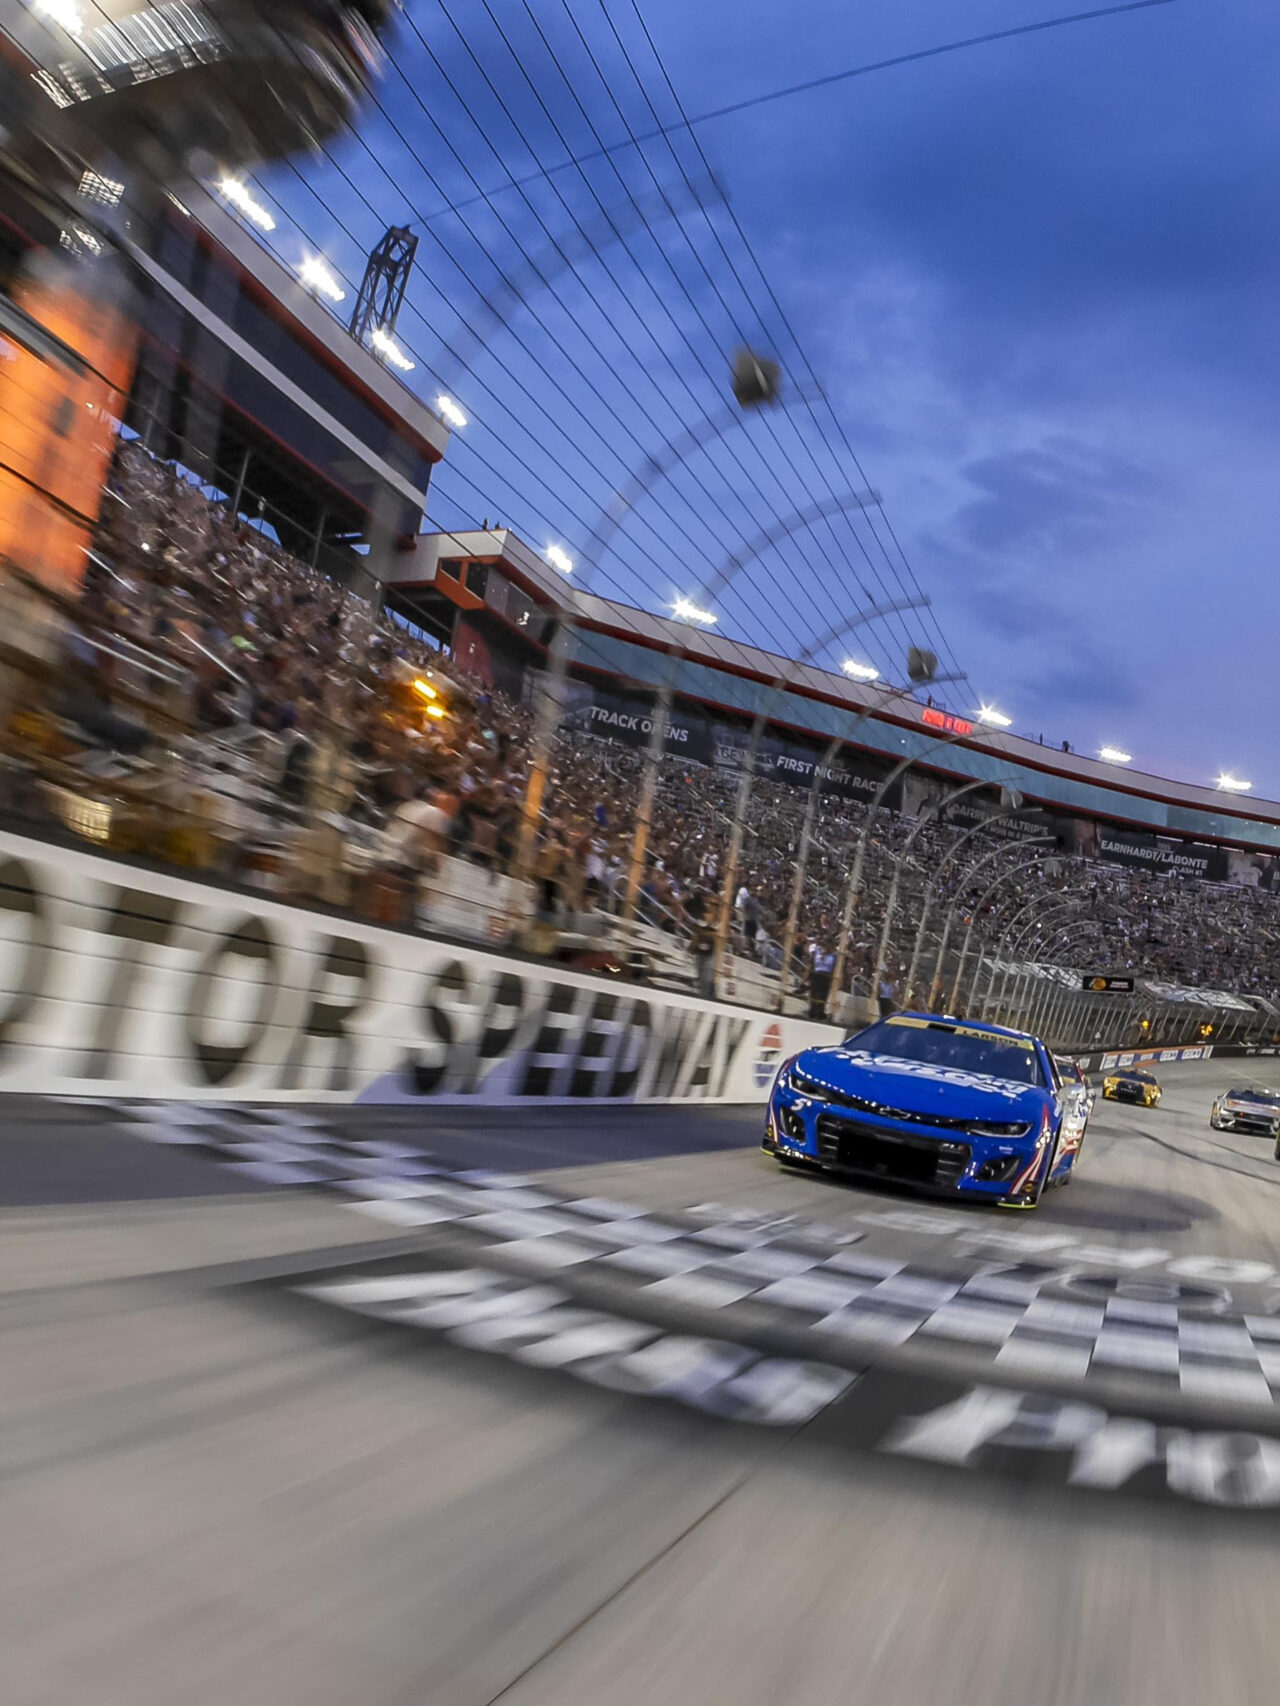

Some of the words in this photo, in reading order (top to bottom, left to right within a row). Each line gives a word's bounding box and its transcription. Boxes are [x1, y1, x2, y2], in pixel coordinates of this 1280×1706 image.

[590, 706, 639, 731] TRACK
[776, 755, 813, 775] FIRST
[814, 765, 852, 786] NIGHT
[1101, 839, 1209, 869] EARNHARDT/LABONTE
[408, 957, 754, 1098] SPEEDWAY
[963, 1029, 1020, 1047] LARSON
